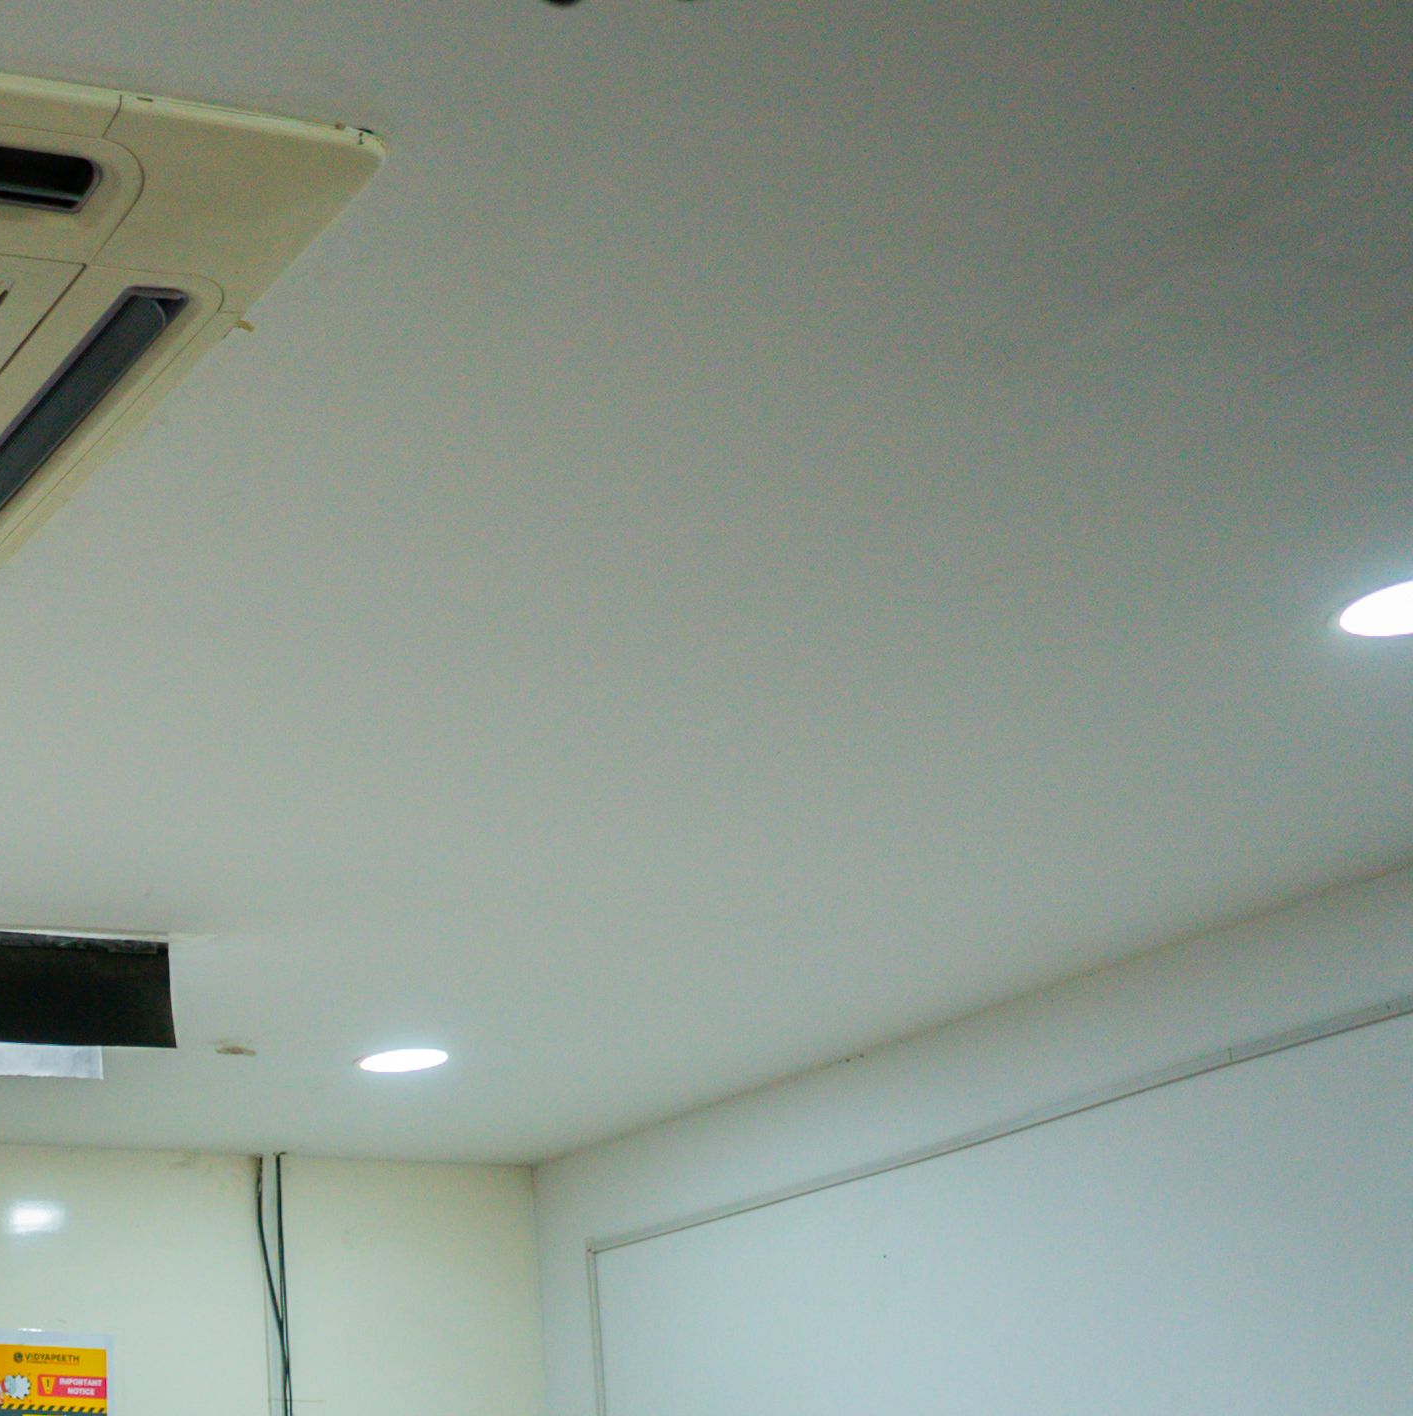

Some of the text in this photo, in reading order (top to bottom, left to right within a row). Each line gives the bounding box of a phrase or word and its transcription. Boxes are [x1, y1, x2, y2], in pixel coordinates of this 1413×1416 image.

[25, 1352, 80, 1362] VIDYAPEETH
[59, 1377, 102, 1387] IMPORTANT
[67, 1387, 95, 1396] NOTICE
